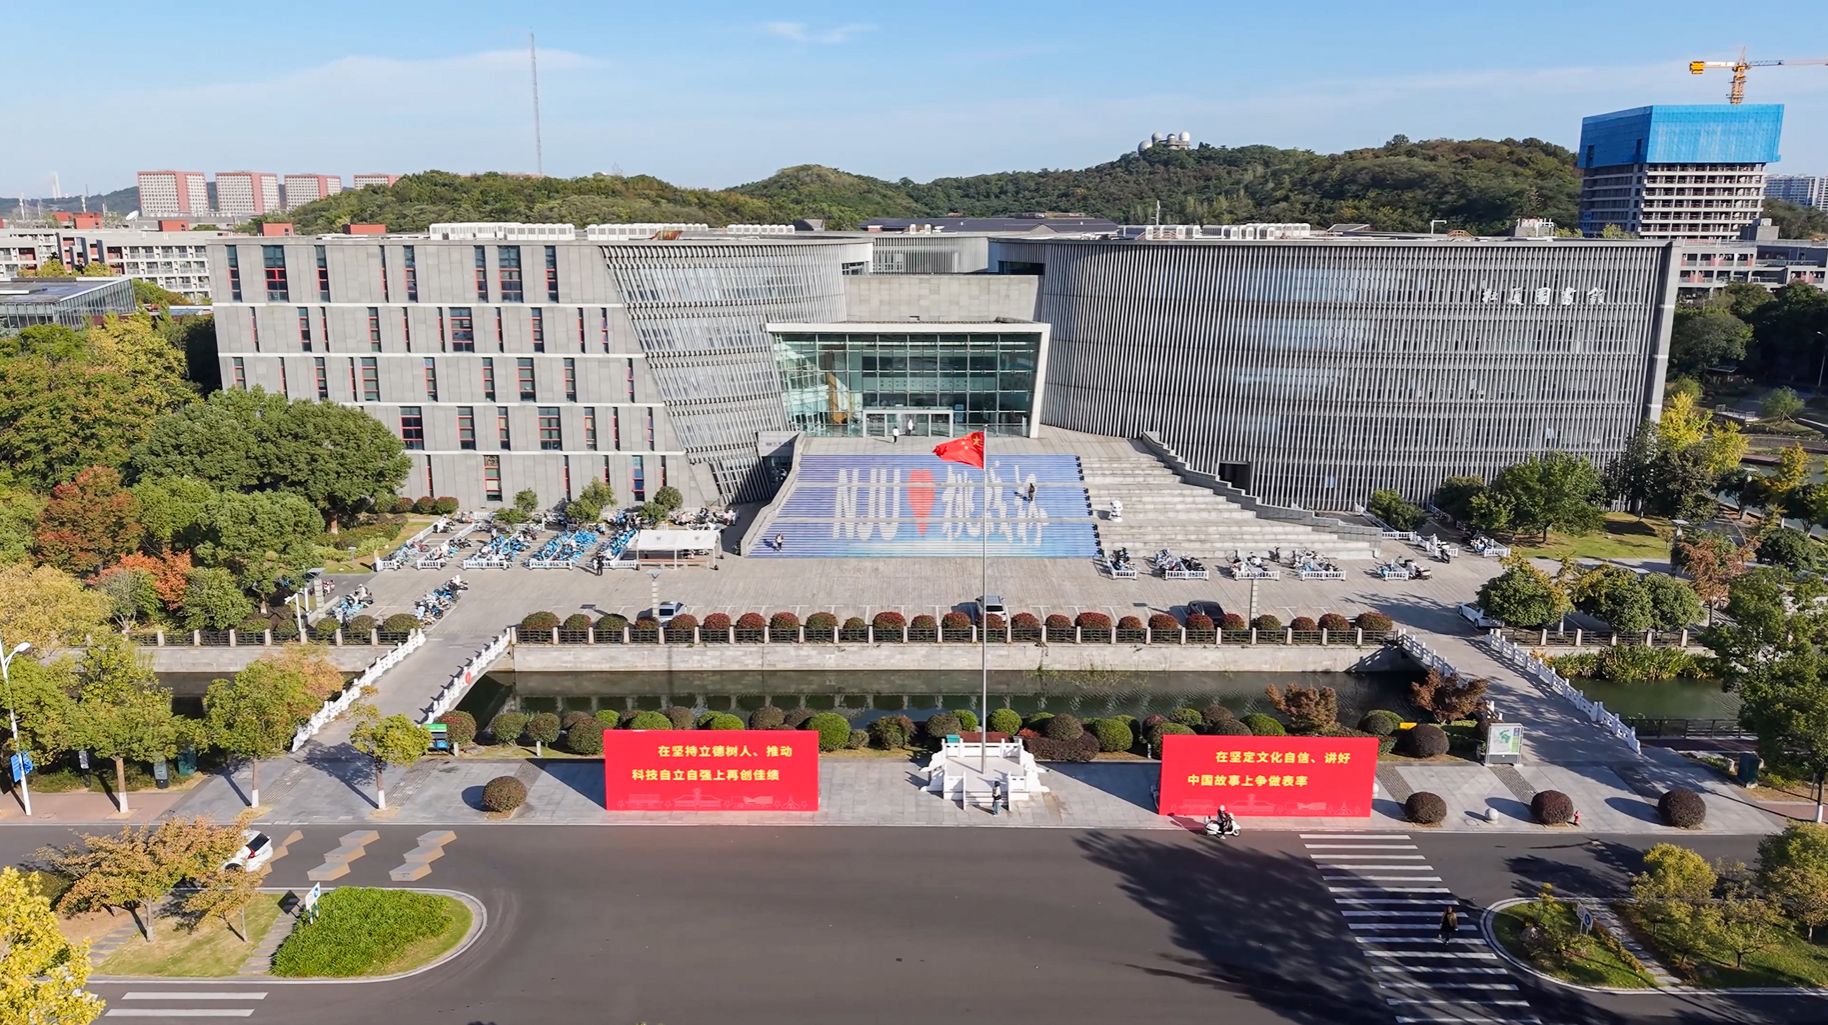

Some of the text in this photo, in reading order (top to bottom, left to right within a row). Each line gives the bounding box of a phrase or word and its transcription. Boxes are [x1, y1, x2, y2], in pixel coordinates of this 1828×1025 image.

[832, 468, 900, 540] NJU
[658, 745, 793, 758] 在坚持立德树人、推动
[1215, 751, 1351, 764] 在坚定文化自信、讲好
[632, 769, 780, 781] 科技自立自强上再创佳绩
[1187, 774, 1308, 787] 中国故事上争做表率
